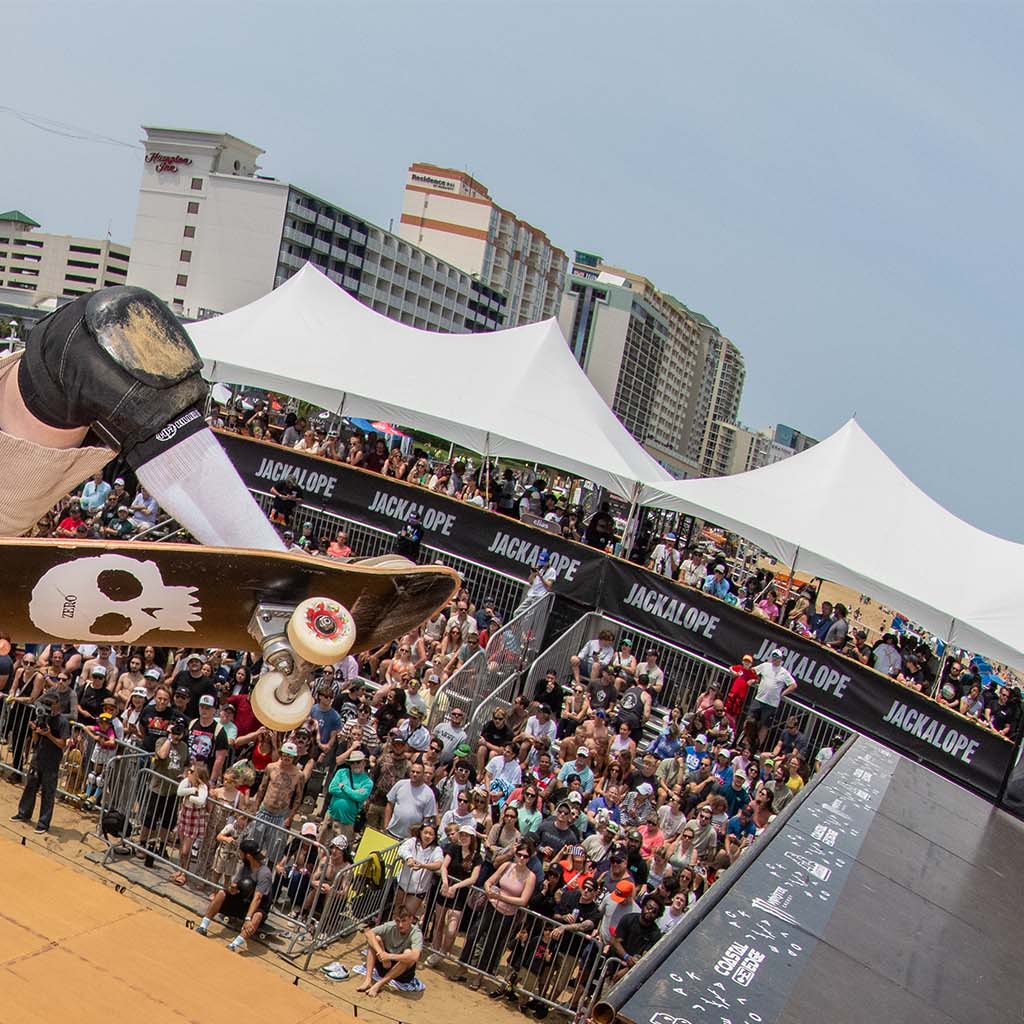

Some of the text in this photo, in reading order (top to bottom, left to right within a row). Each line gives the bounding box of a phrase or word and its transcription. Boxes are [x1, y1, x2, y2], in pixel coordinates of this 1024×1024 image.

[488, 531, 582, 582] JACKAOPE
[61, 595, 78, 619] ZERO
[624, 583, 721, 639] JACKALOPE
[882, 700, 980, 764] JACKALOPE
[713, 941, 749, 976] COASTAL
[741, 948, 766, 973] EDGE
